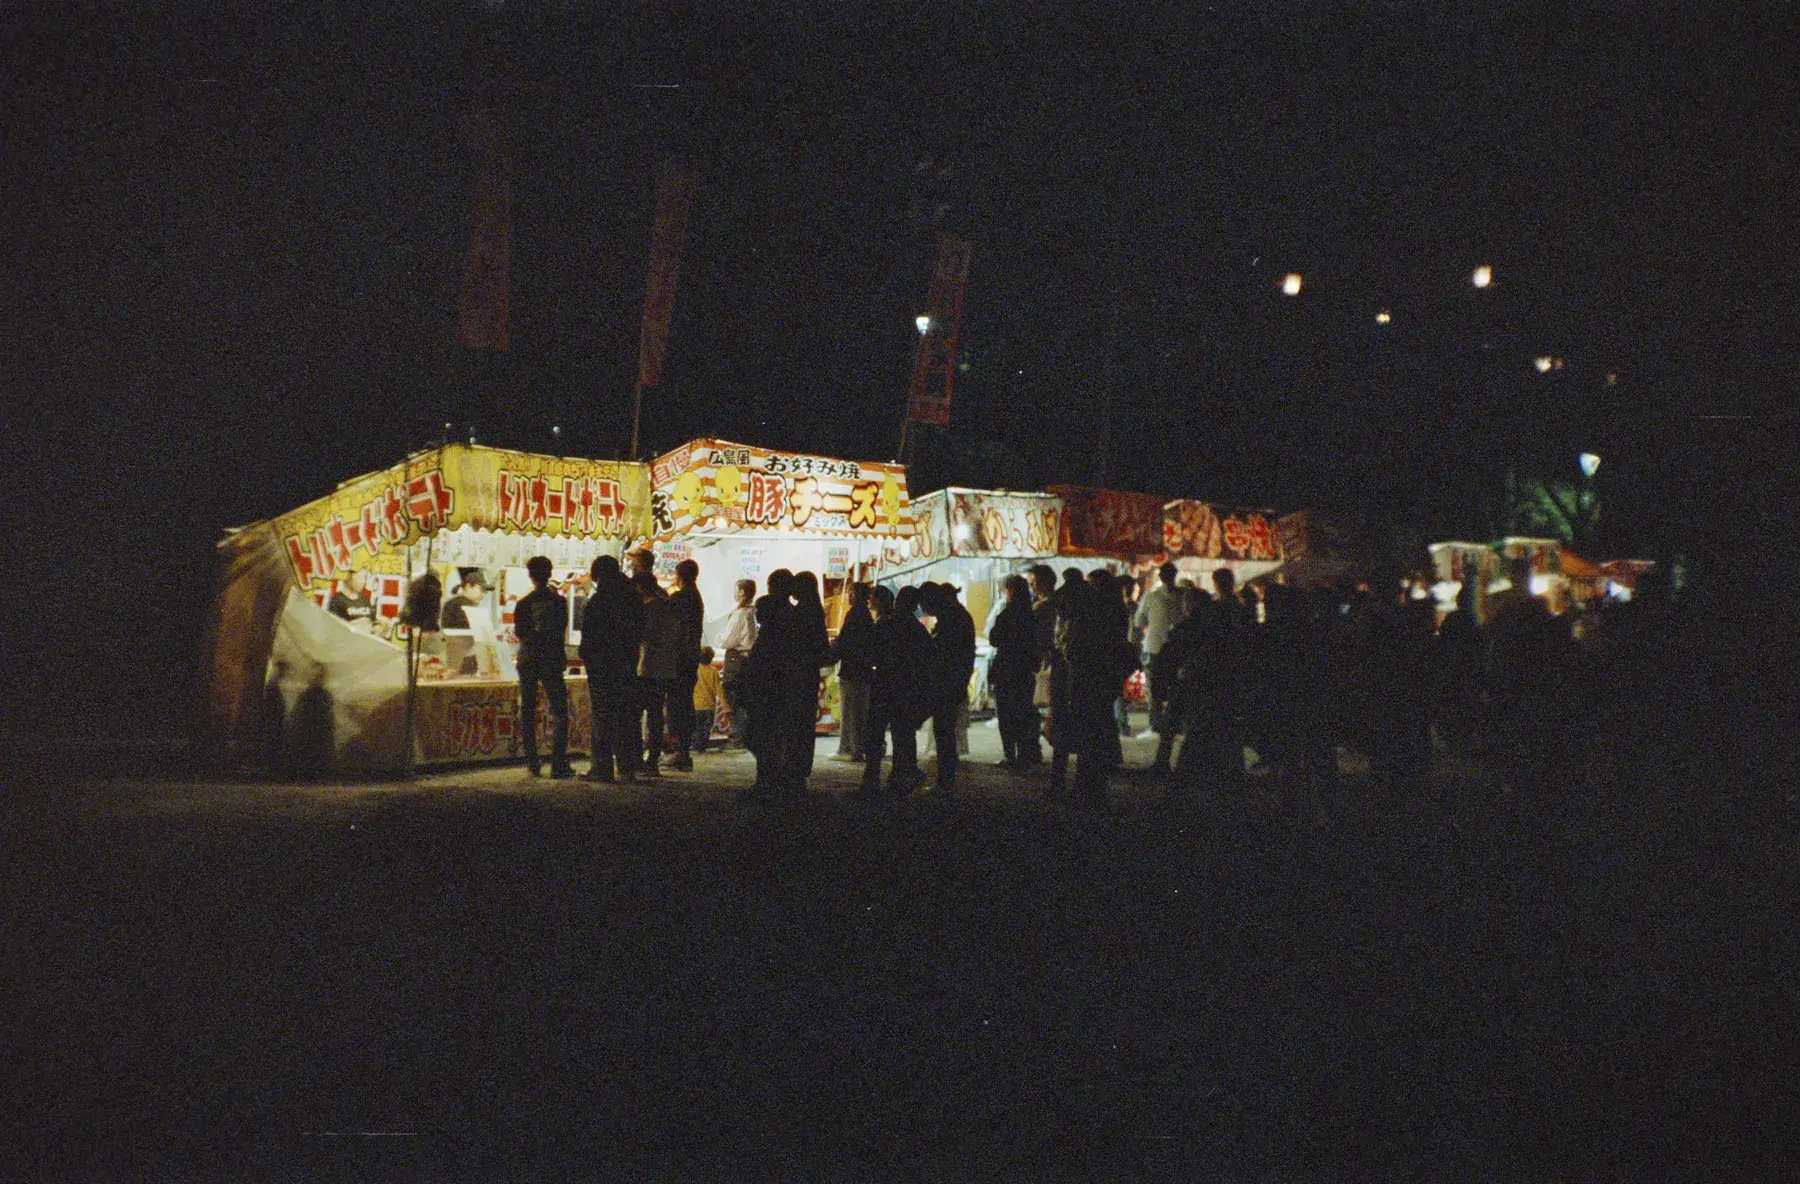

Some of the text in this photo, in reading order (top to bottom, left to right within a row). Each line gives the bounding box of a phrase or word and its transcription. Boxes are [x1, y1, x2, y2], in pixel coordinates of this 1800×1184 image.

[709, 449, 861, 480] 広島風 お好み焼
[498, 468, 627, 535] トルネードポテト
[746, 469, 788, 525] 豚
[284, 470, 456, 591] トルネードポテト
